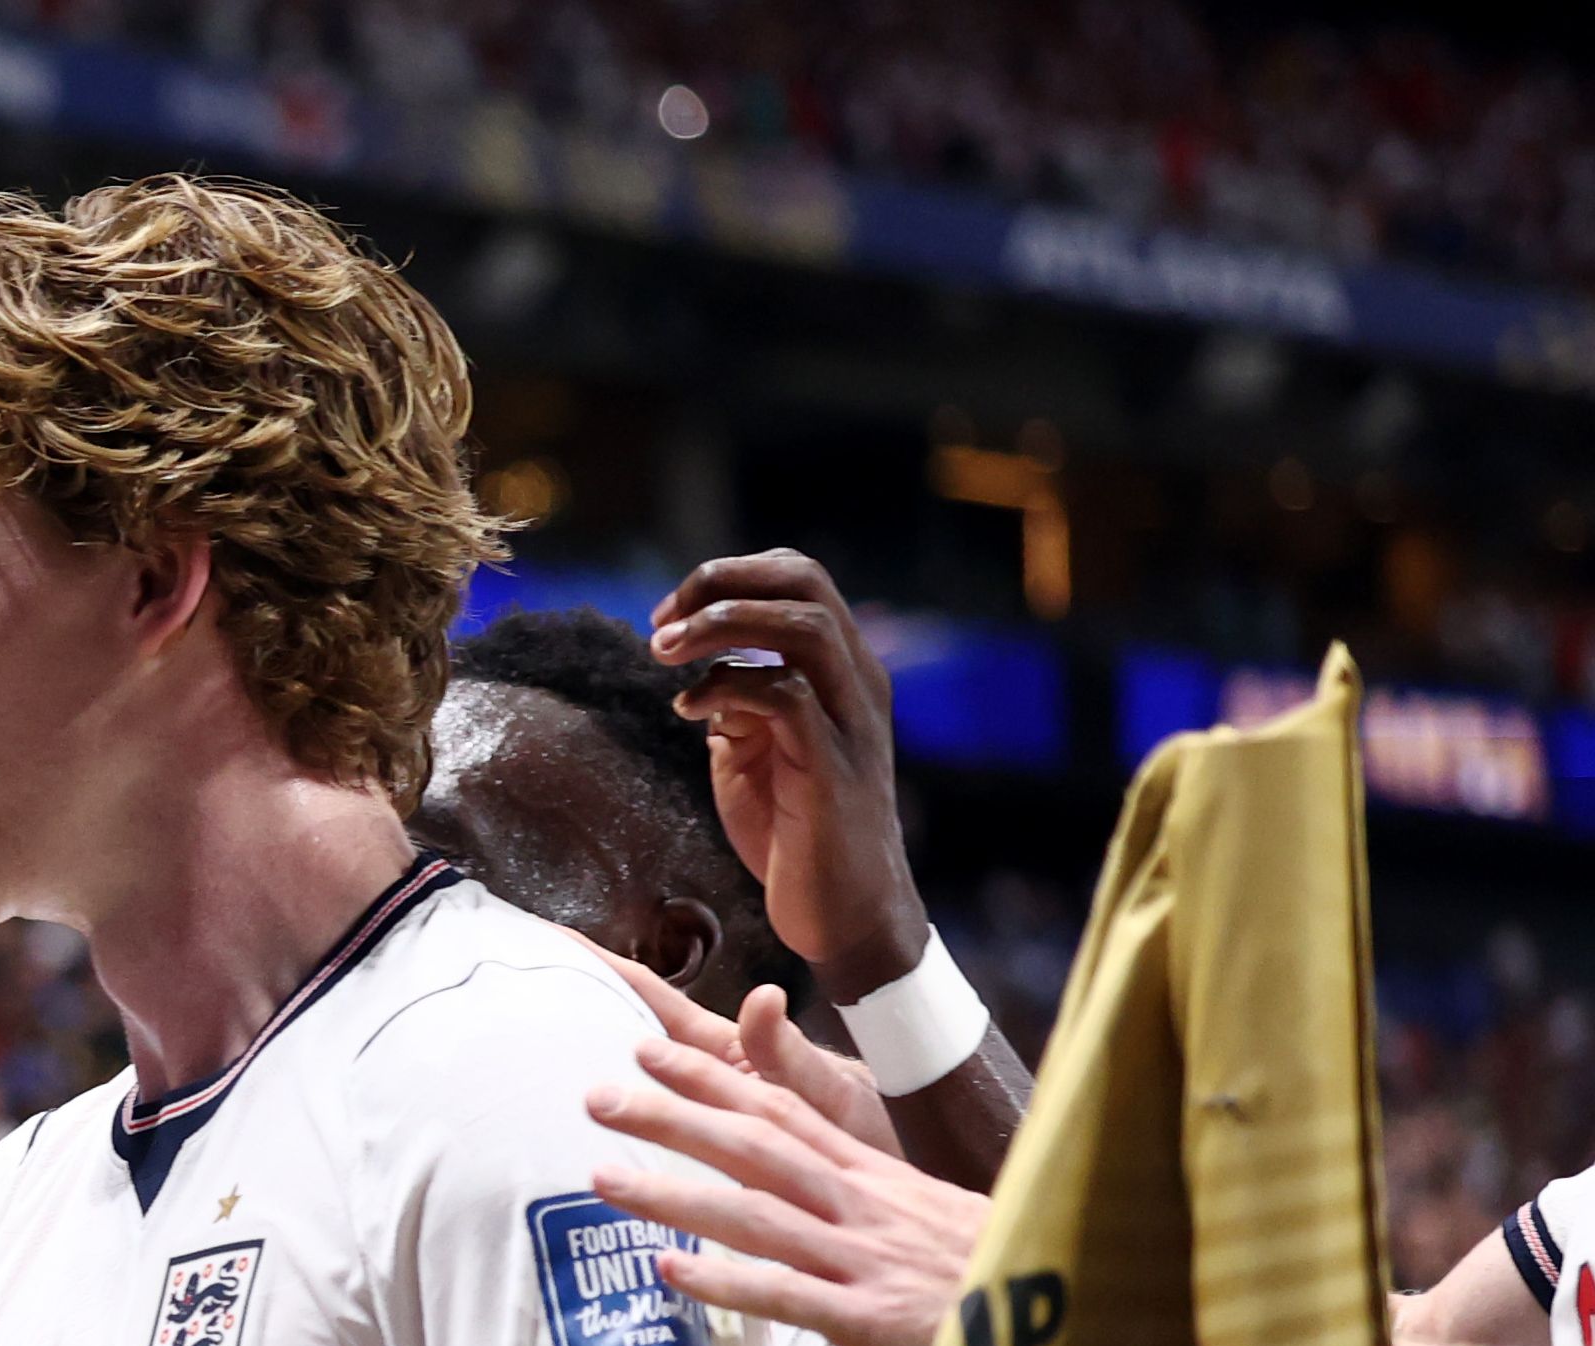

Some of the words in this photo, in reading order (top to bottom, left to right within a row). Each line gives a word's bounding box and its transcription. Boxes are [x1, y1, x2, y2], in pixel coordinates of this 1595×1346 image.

[567, 1218, 679, 1258] FOOTBALL
[574, 1248, 659, 1300] UNIT
[574, 1300, 627, 1338] the
